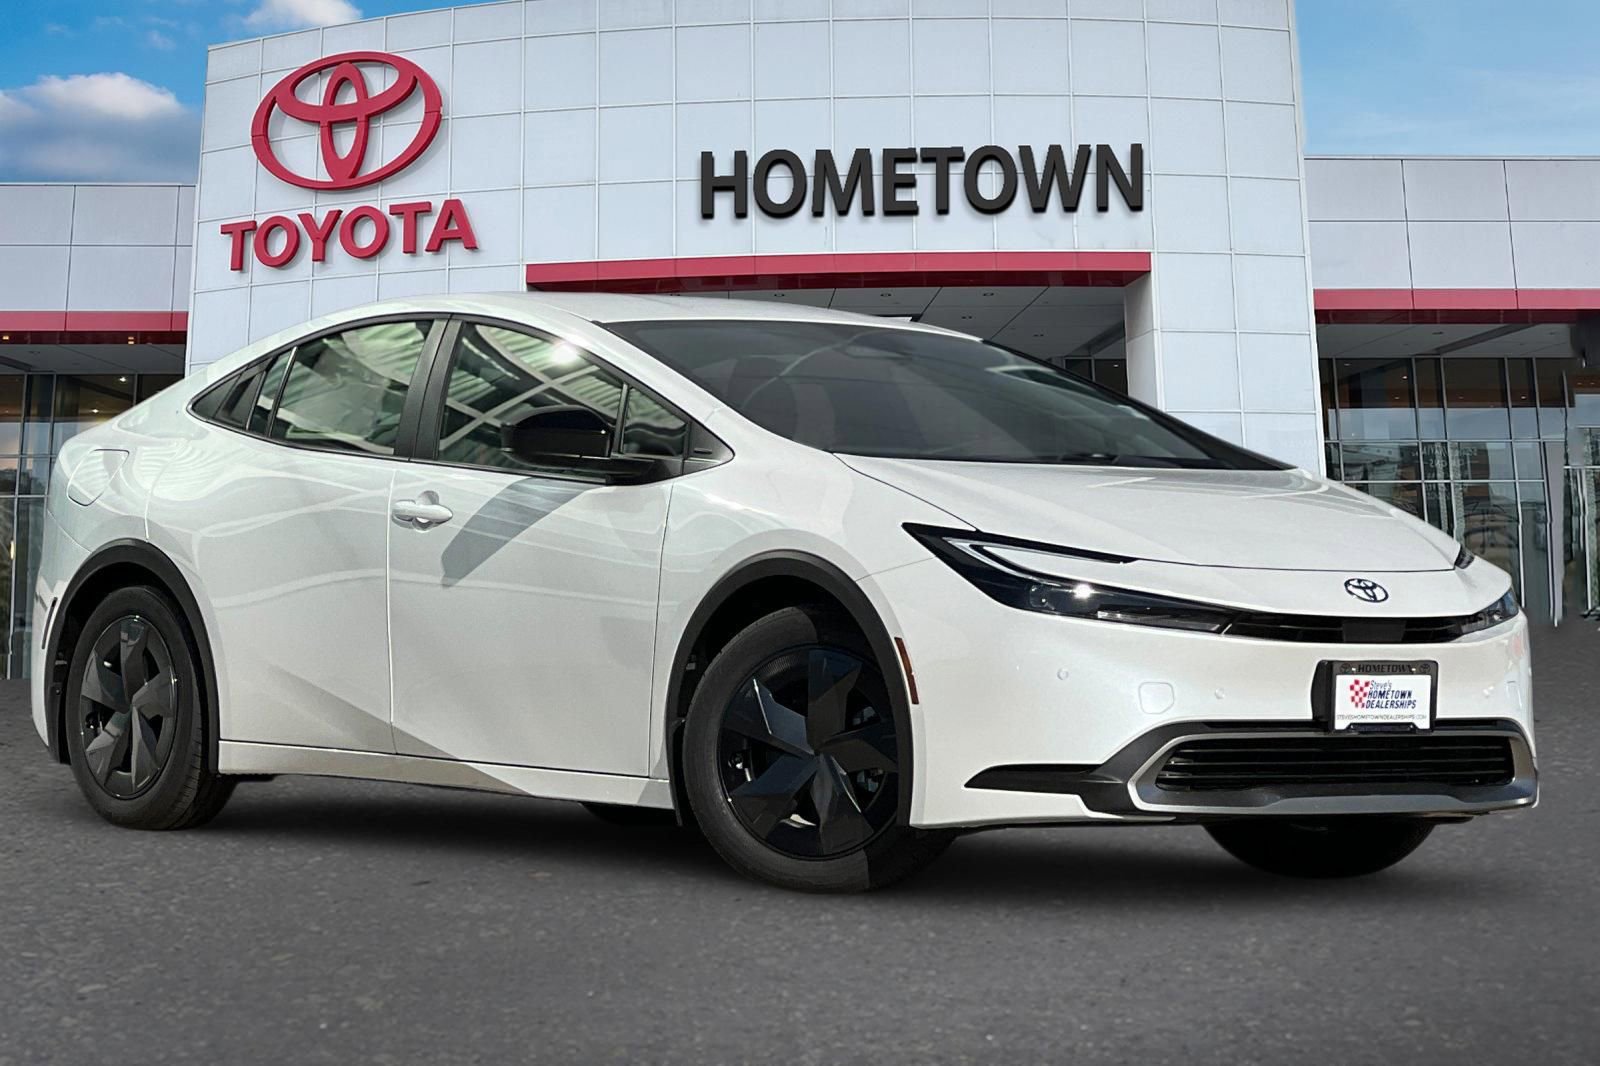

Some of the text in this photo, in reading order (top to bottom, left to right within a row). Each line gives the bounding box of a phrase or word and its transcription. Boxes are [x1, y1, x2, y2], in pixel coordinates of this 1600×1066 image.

[700, 143, 1144, 219] HOMETOWN
[220, 198, 478, 271] TOYOTA
[1366, 700, 1416, 709] DEALERSHIPS
[1368, 690, 1412, 699] HOMETOWN
